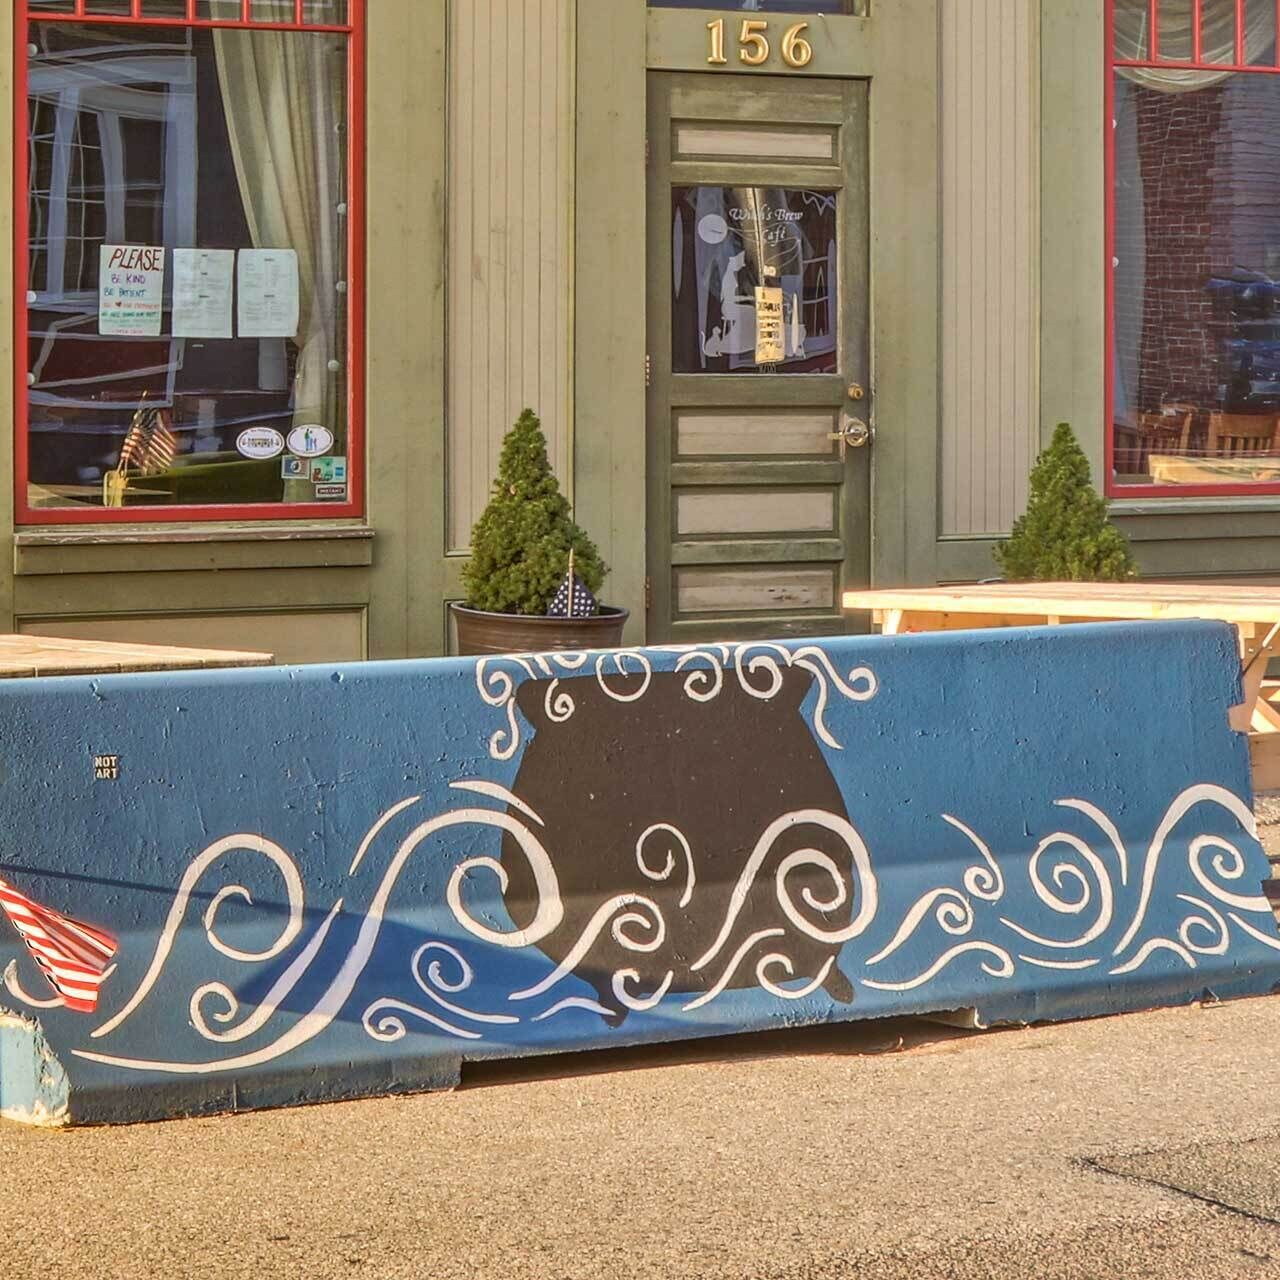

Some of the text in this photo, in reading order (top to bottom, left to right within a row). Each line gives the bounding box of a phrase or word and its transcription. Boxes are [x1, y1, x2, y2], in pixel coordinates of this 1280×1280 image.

[707, 18, 812, 67] 156
[774, 208, 803, 220] Brew
[111, 273, 145, 284] BE KIND
[104, 287, 114, 297] BE
[95, 756, 117, 767] NOT
[96, 768, 117, 779] ART
